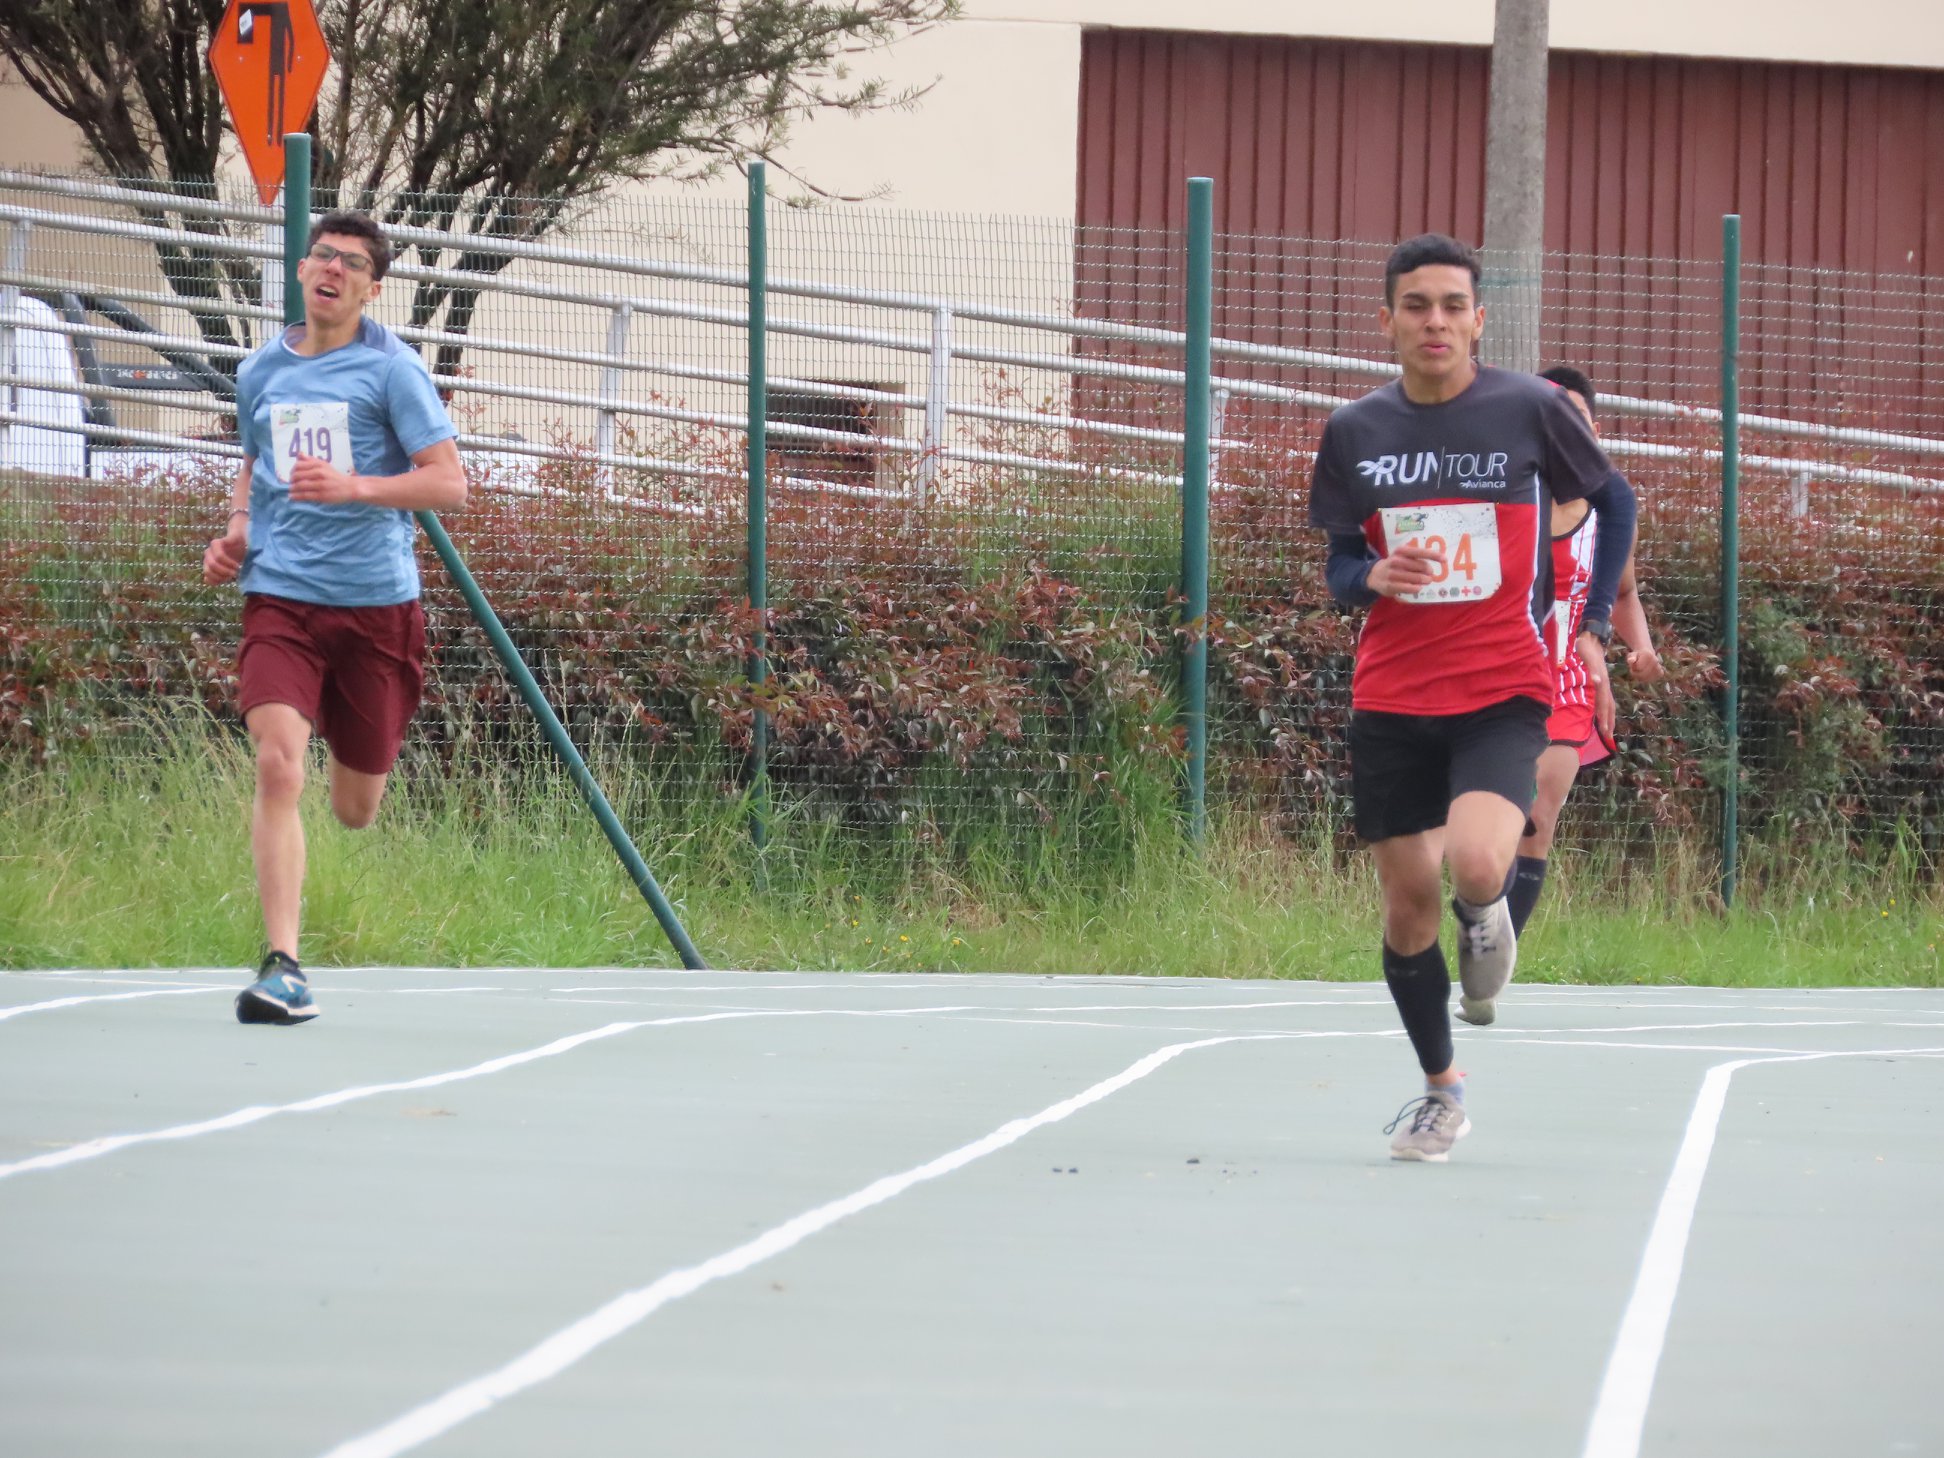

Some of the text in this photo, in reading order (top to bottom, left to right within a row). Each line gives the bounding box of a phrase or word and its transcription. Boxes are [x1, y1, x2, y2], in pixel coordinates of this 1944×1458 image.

[288, 426, 333, 463] 419
[1373, 451, 1508, 486] RUN TOUR
[1464, 478, 1506, 489] Avianca
